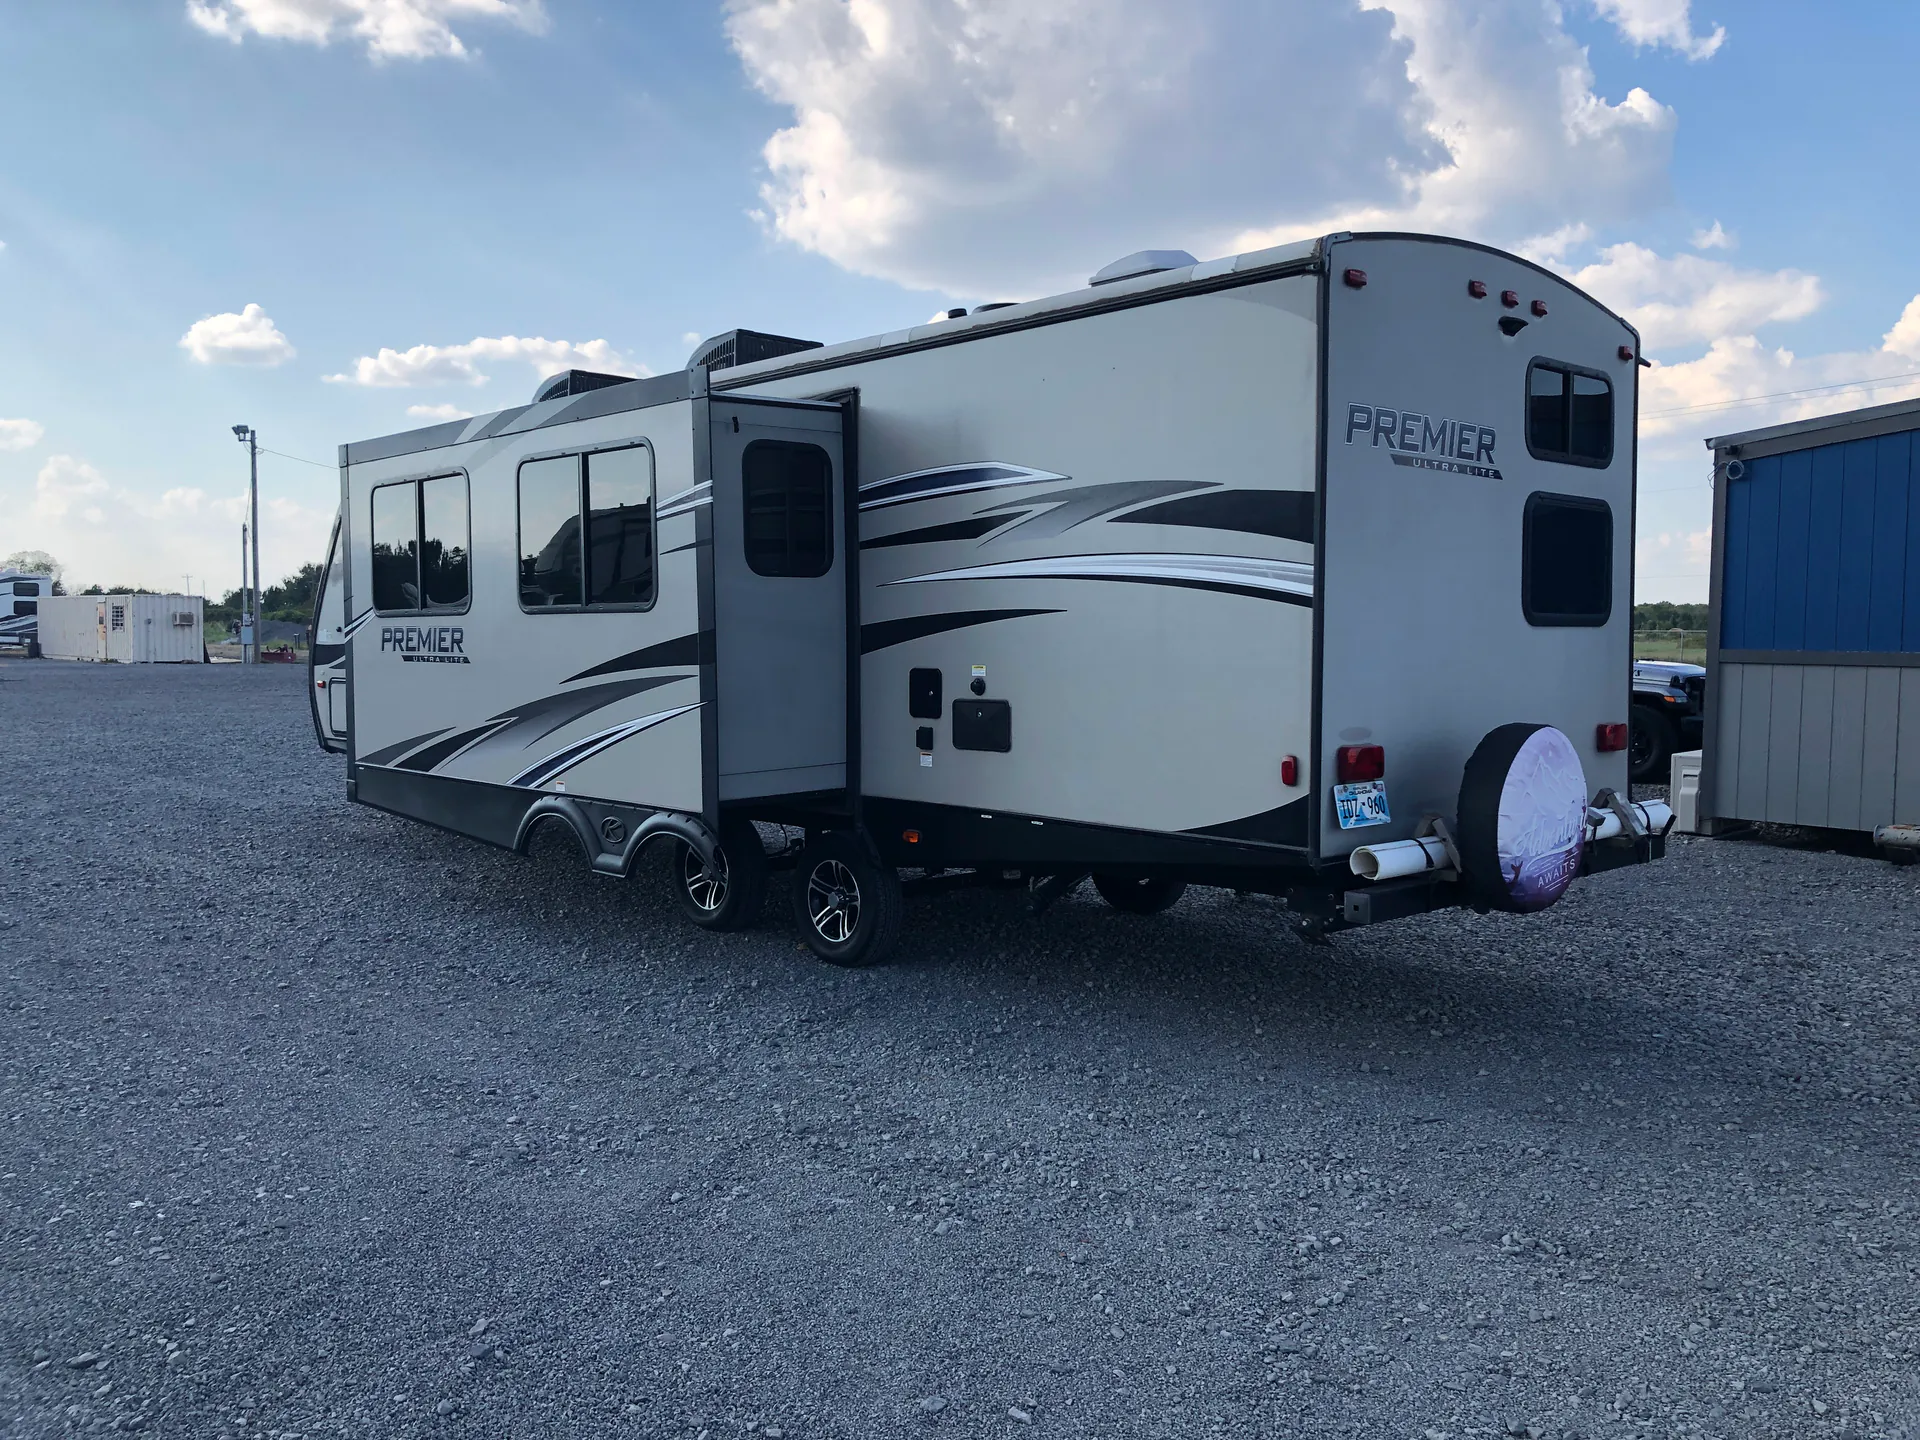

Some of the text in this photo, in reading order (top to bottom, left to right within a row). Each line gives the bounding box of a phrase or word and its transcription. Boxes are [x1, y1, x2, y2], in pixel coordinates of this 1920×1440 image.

[1344, 402, 1496, 467] PREMIER
[1412, 458, 1495, 479] ULTRA LITE
[381, 626, 465, 653] PREMIER
[444, 656, 465, 664] LITE
[1537, 858, 1576, 888] AWAITS
